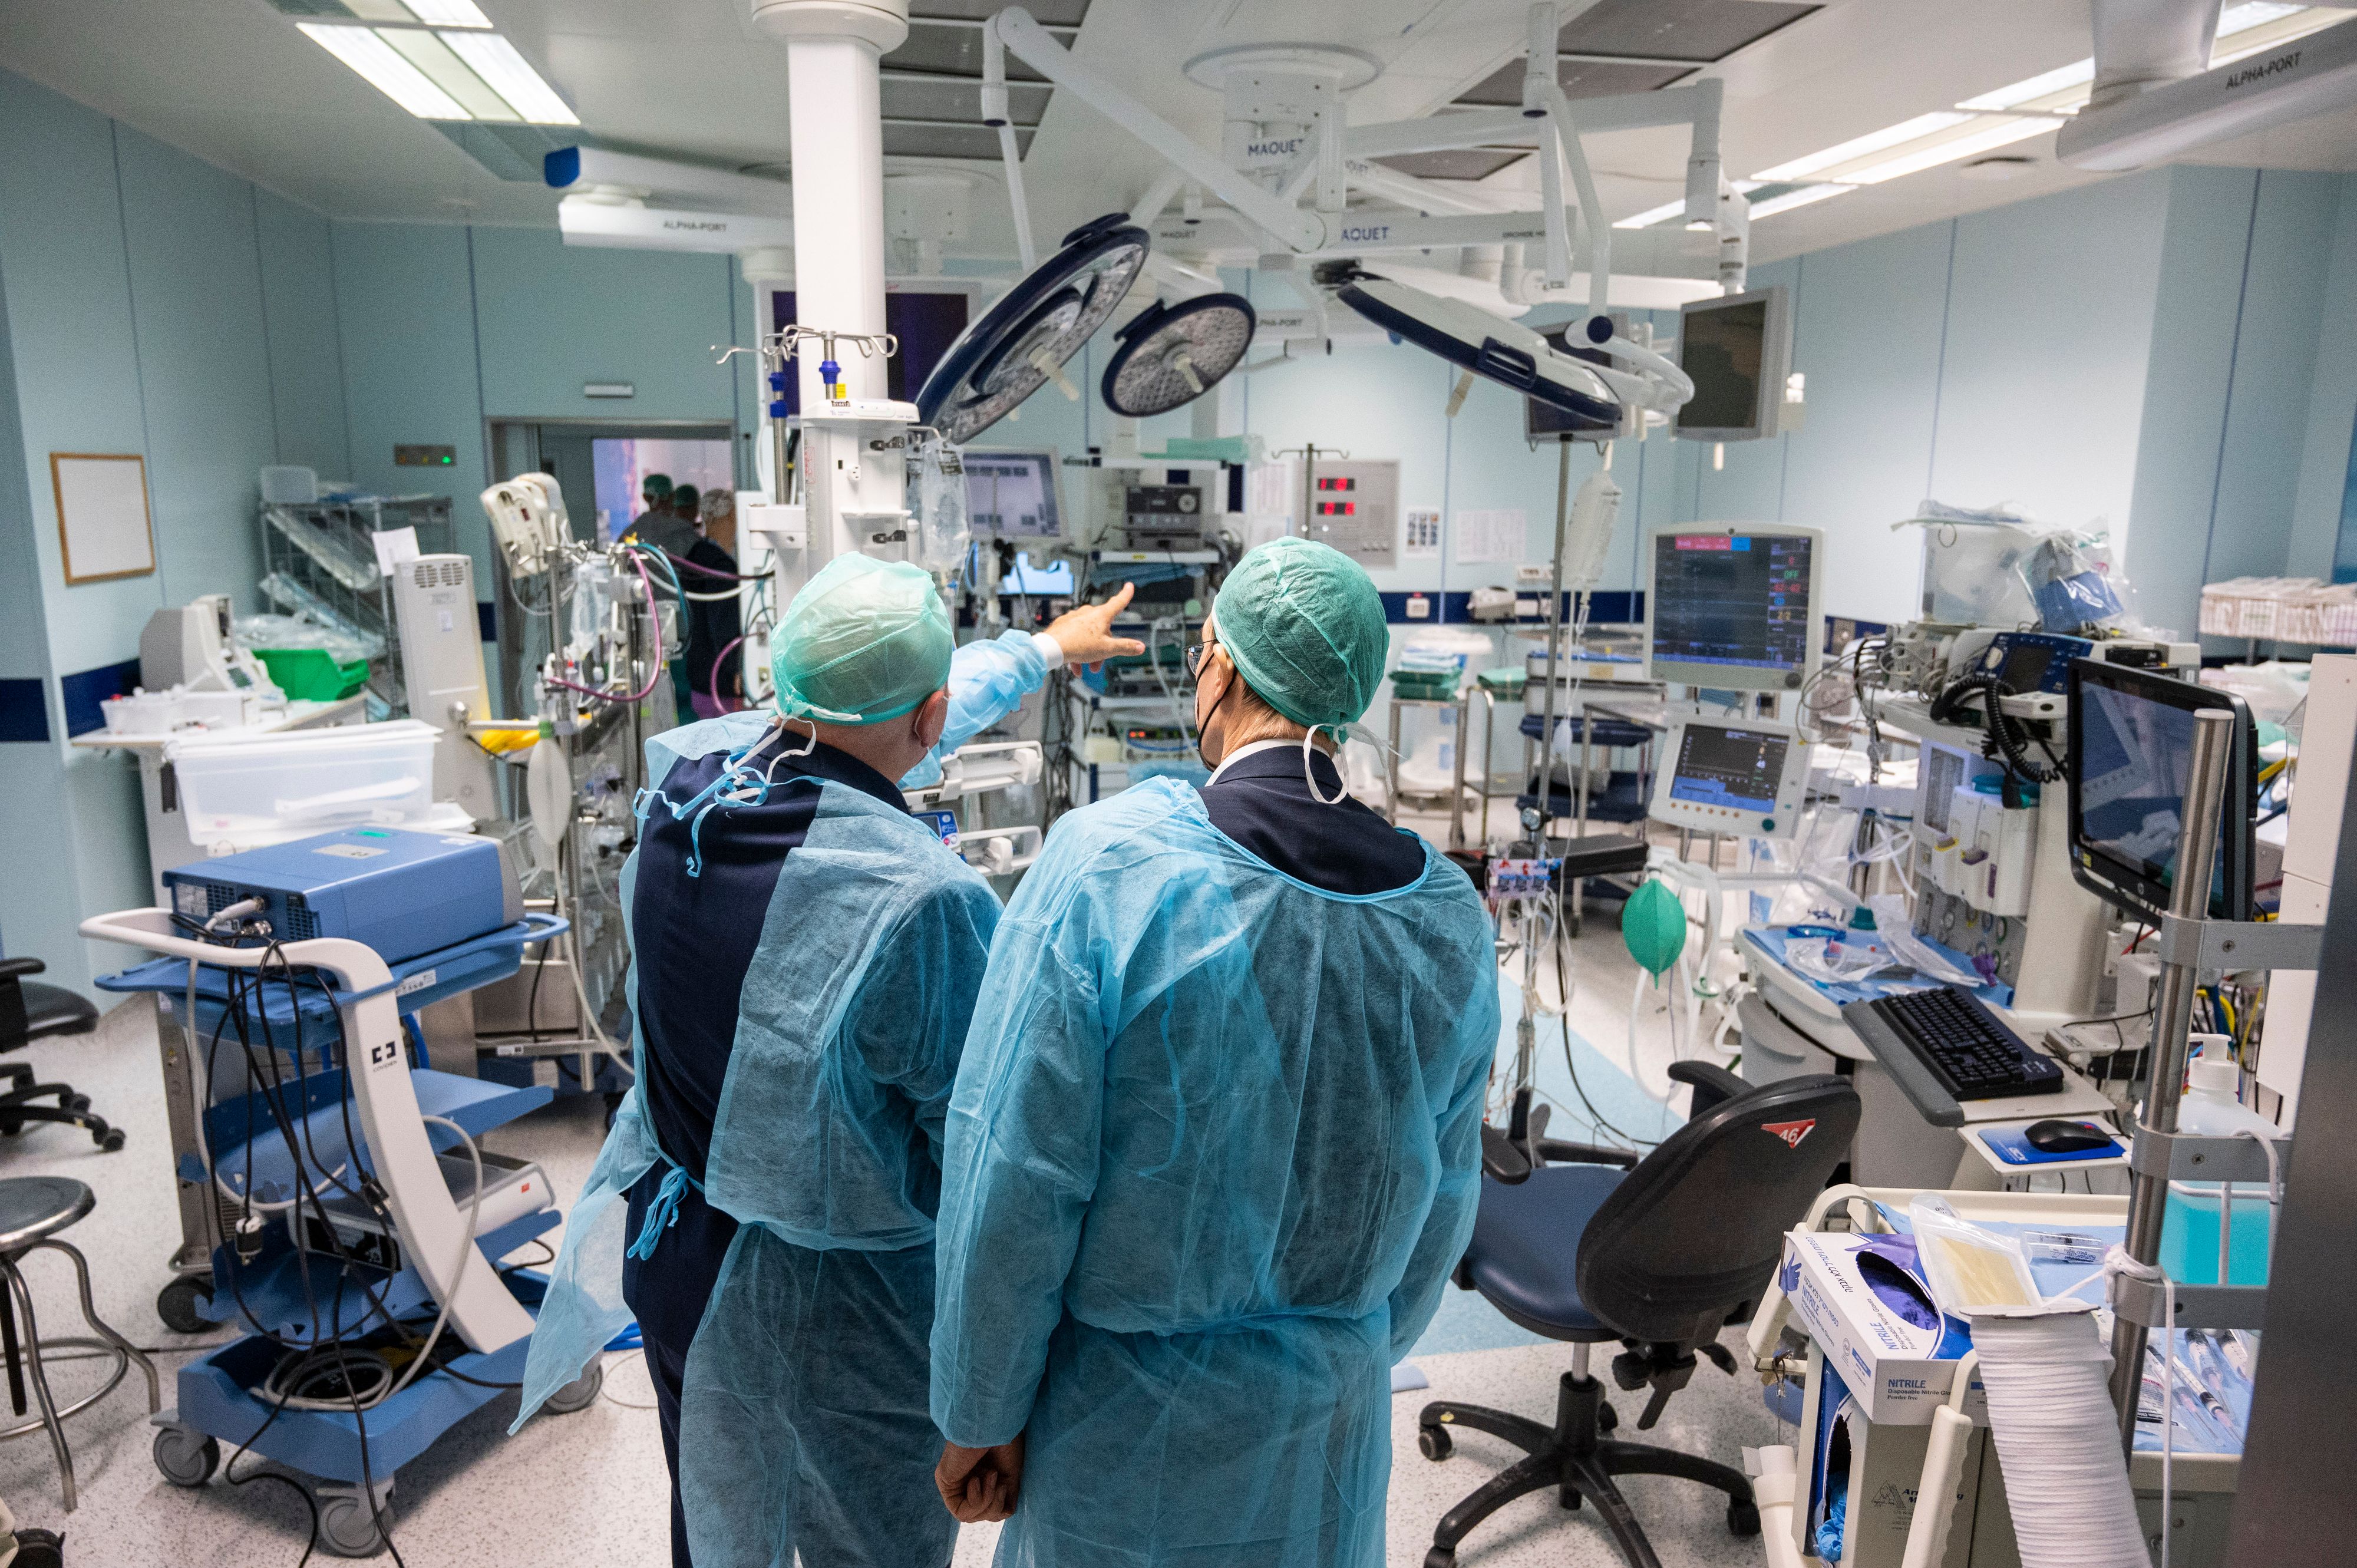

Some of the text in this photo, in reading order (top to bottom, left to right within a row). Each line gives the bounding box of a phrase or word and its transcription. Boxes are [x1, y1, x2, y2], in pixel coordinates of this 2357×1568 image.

[2226, 51, 2301, 90] ALPHA-PORT
[663, 221, 726, 232] ALPHA-PORT
[1341, 226, 1389, 242] AQUET
[1828, 1267, 1842, 1277] ללא
[1837, 1277, 1853, 1292] אבקה
[1802, 1285, 1820, 1316] NITRILE
[1867, 1298, 1909, 1349] Disposable Nitrile Gloves
[1869, 1322, 1899, 1349] NITRILE
[1897, 1326, 1917, 1349] Powder free
[1888, 1379, 1926, 1388] NITRILE
